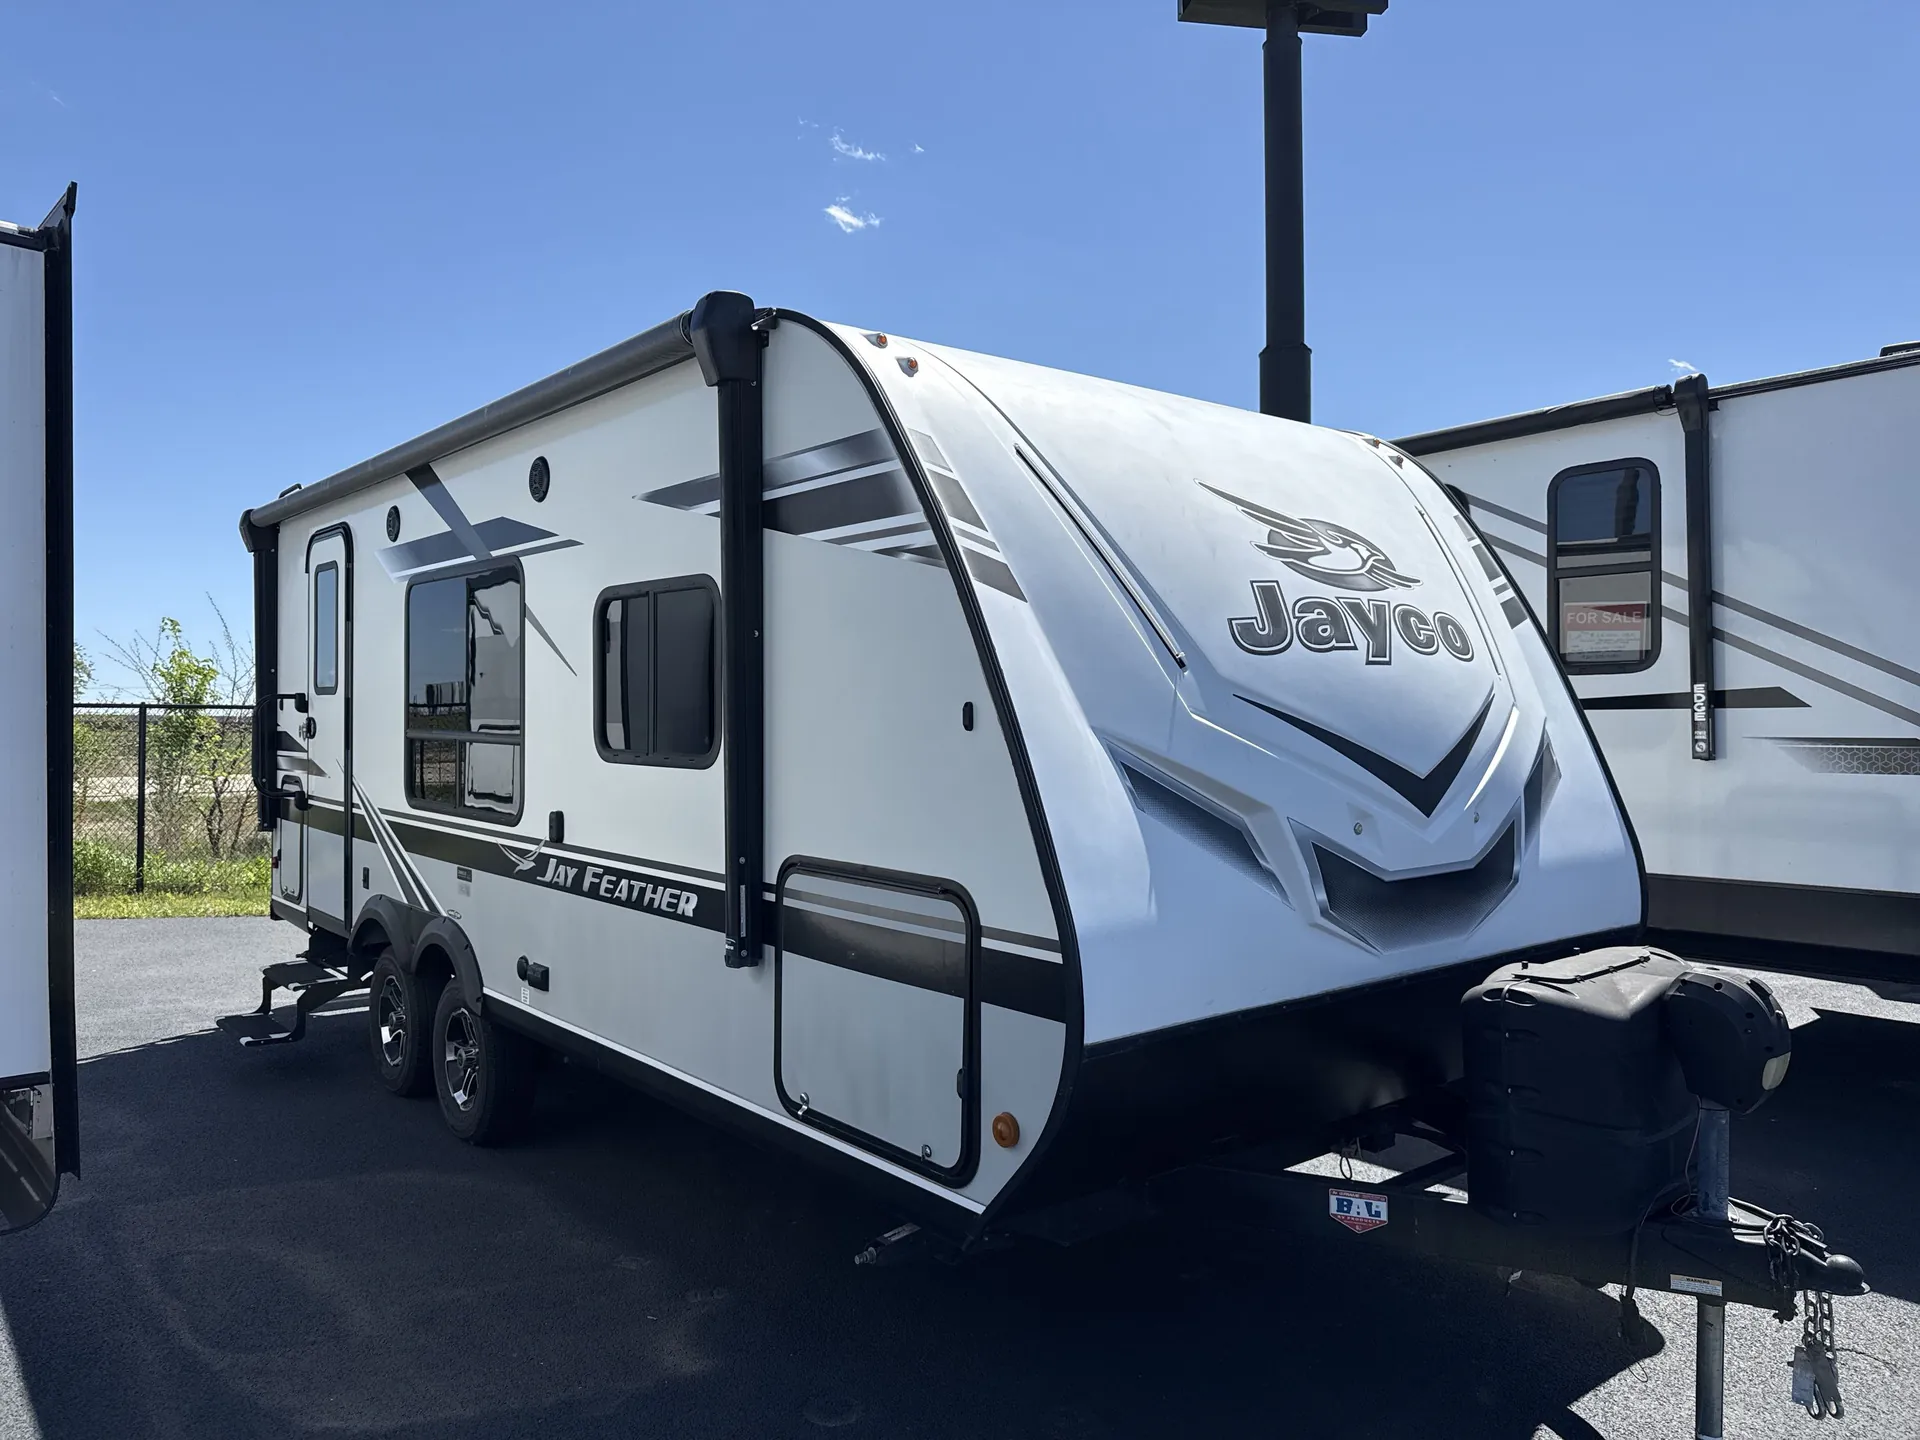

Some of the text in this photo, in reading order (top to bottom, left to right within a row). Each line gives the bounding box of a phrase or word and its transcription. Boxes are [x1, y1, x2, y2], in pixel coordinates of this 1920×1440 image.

[1227, 580, 1474, 666] Jayco
[1567, 611, 1641, 624] FOR SALE
[1693, 684, 1706, 722] EDGE
[582, 866, 698, 917] FEATHER
